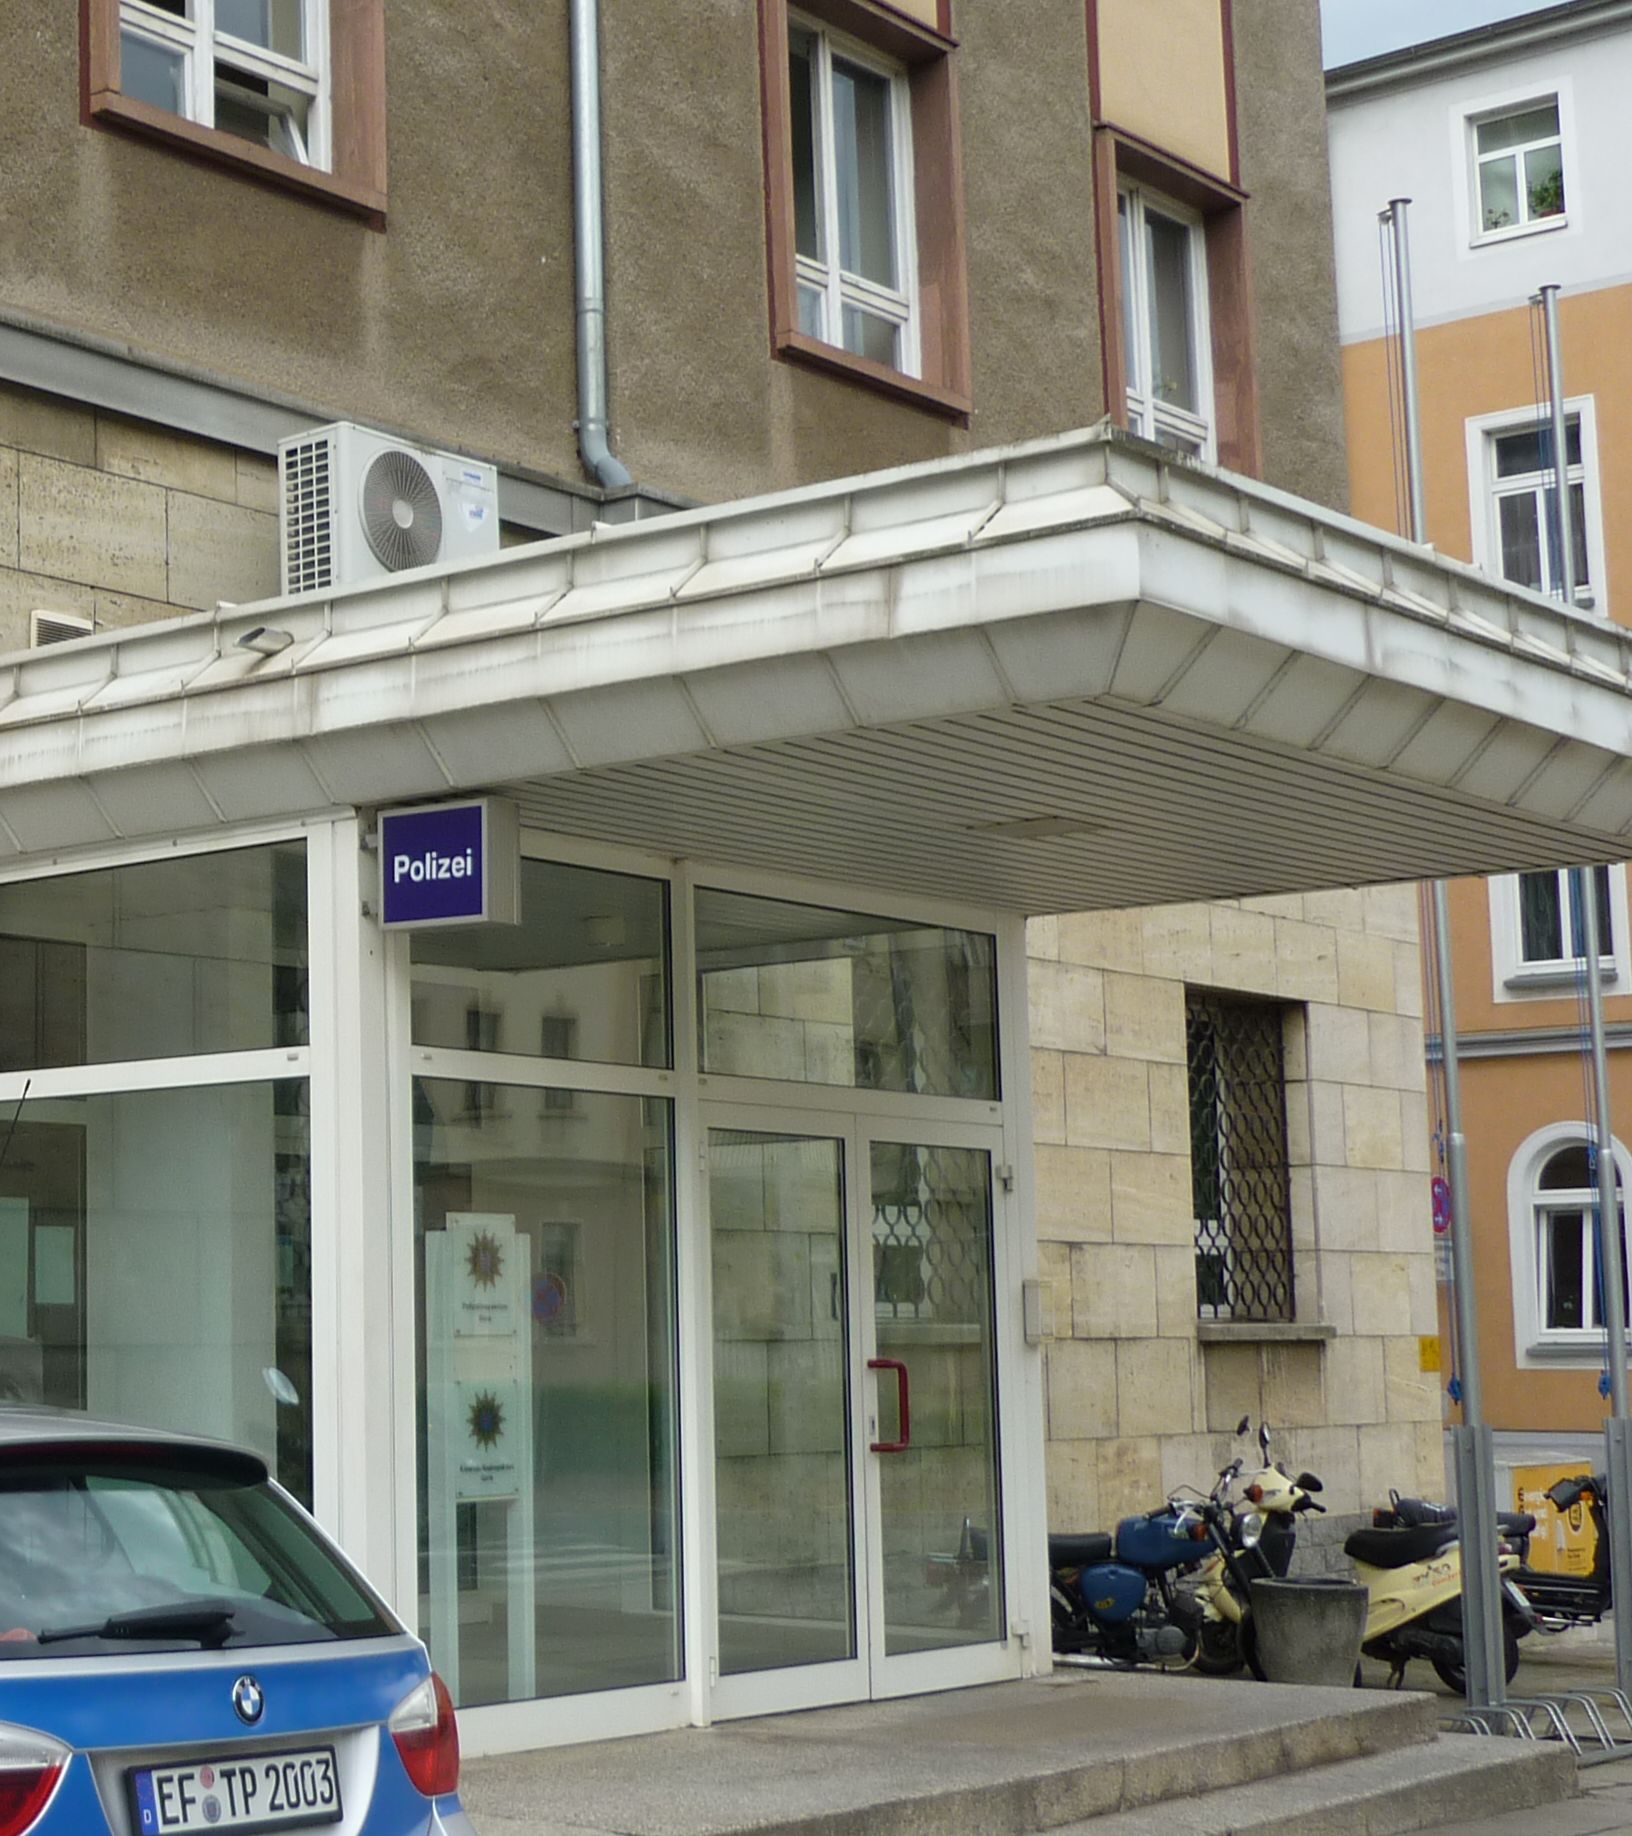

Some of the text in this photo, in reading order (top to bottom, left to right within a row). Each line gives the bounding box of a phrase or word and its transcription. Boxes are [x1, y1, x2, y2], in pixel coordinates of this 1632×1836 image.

[393, 847, 473, 884] Polizei
[143, 1757, 334, 1825] D EF TP 2003
